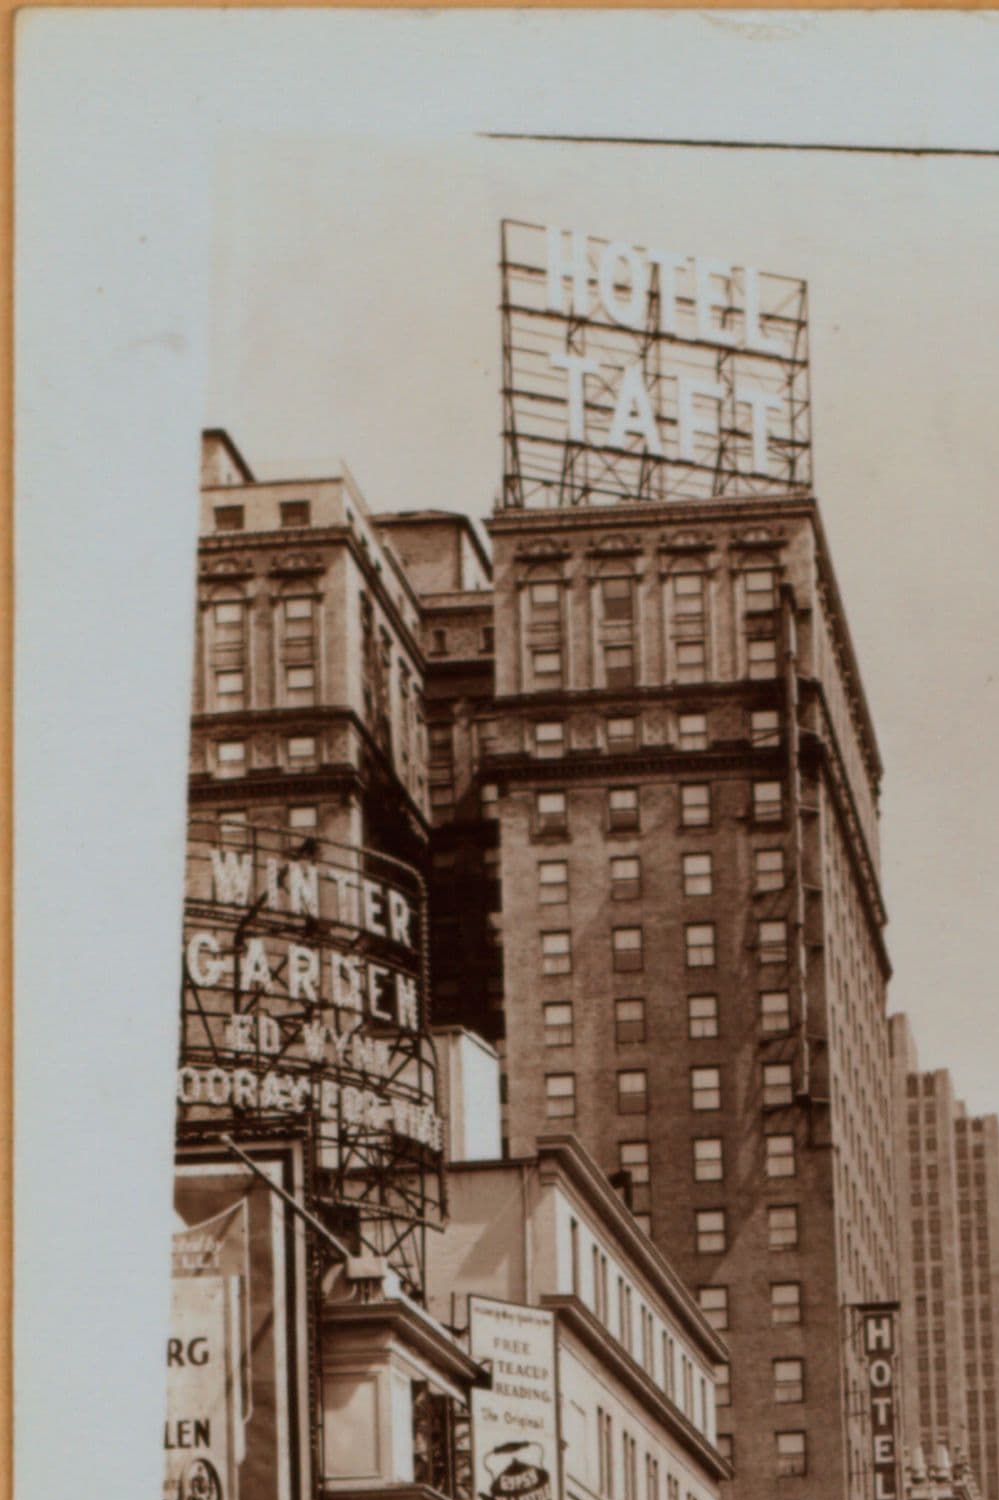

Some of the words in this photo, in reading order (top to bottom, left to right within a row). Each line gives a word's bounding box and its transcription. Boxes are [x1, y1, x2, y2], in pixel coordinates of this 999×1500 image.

[545, 226, 785, 355] HOTEL
[549, 352, 788, 474] TAFT
[210, 849, 412, 949] WINTER
[186, 932, 420, 1031] GARDEN
[494, 1337, 530, 1355] FREE
[868, 1317, 896, 1500] HOTEL
